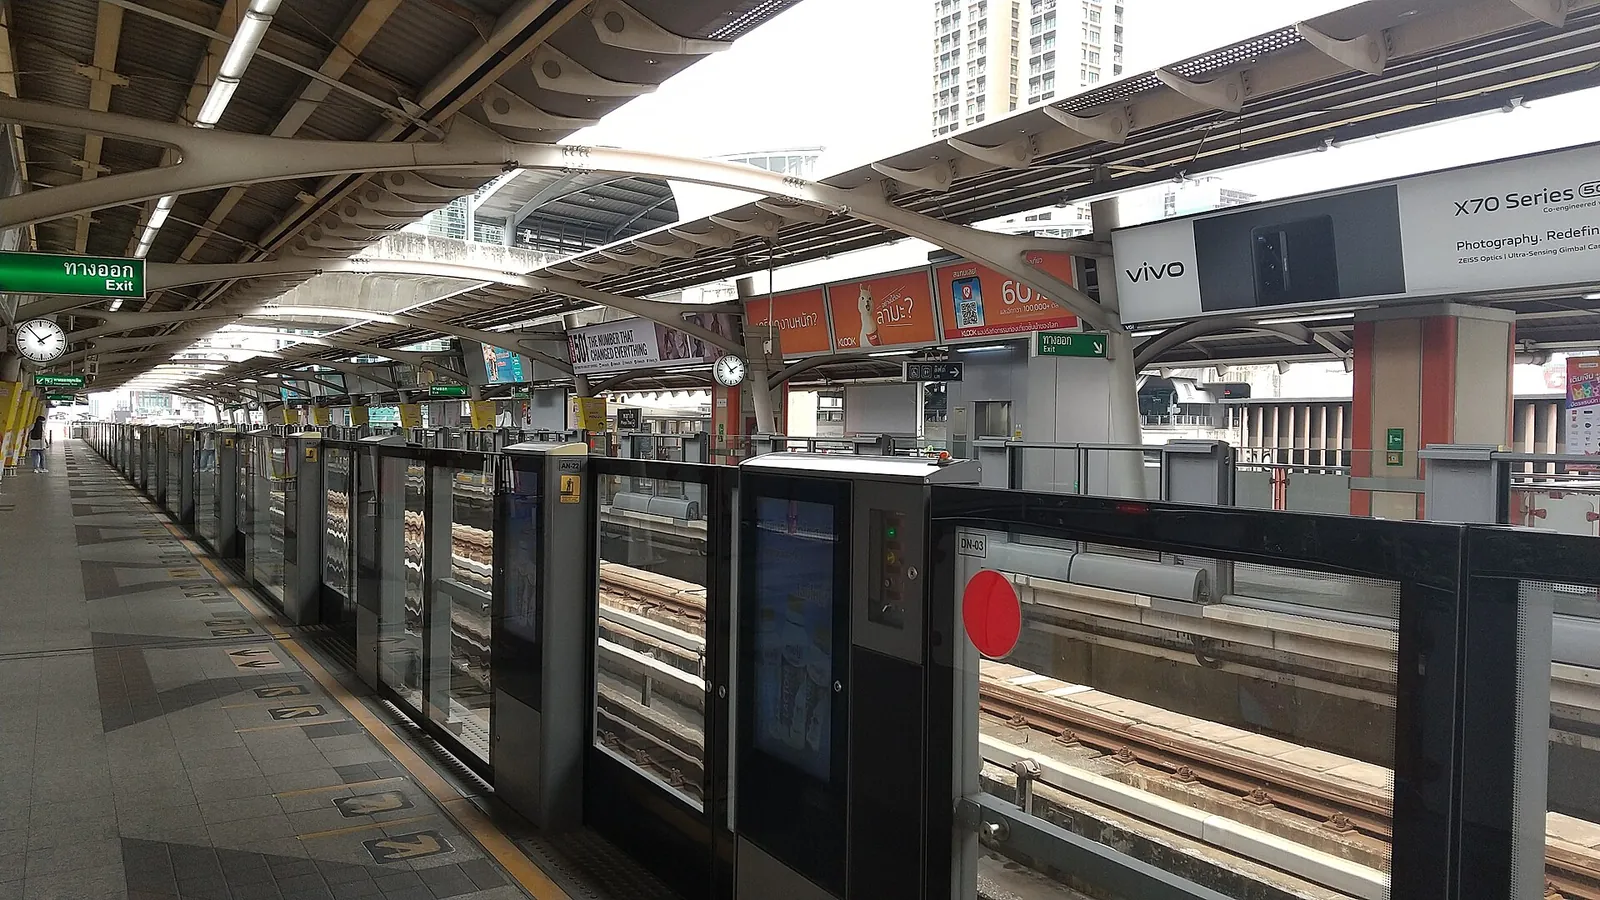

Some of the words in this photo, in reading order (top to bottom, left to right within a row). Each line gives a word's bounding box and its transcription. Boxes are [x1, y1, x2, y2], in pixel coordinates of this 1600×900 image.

[1454, 196, 1500, 217] X70
[1505, 187, 1575, 210] Series
[1543, 200, 1597, 213] Co-engineered
[1456, 233, 1543, 251] Photography.
[1546, 225, 1600, 242] Redefin
[1458, 256, 1479, 264] ZEISS
[1480, 254, 1503, 263] Optics
[1507, 247, 1558, 260] Ultra-Sensing
[1558, 244, 1586, 254] Gimbal
[63, 261, 134, 278] ทางออก
[1125, 261, 1185, 283] vivo
[105, 279, 134, 291] Exit
[876, 296, 914, 325] ลามะ?
[588, 335, 598, 348] THE
[598, 332, 621, 346] NUMBER
[620, 330, 634, 343] THAT
[961, 328, 977, 337] KLOOK
[1042, 334, 1072, 347] ทางออก
[573, 332, 590, 363] 501
[837, 336, 857, 347] KLOOK
[1043, 345, 1056, 353] Exit
[590, 346, 614, 361] CHANGED
[614, 343, 648, 358] EVERYTHING
[961, 538, 984, 551] DN-03
